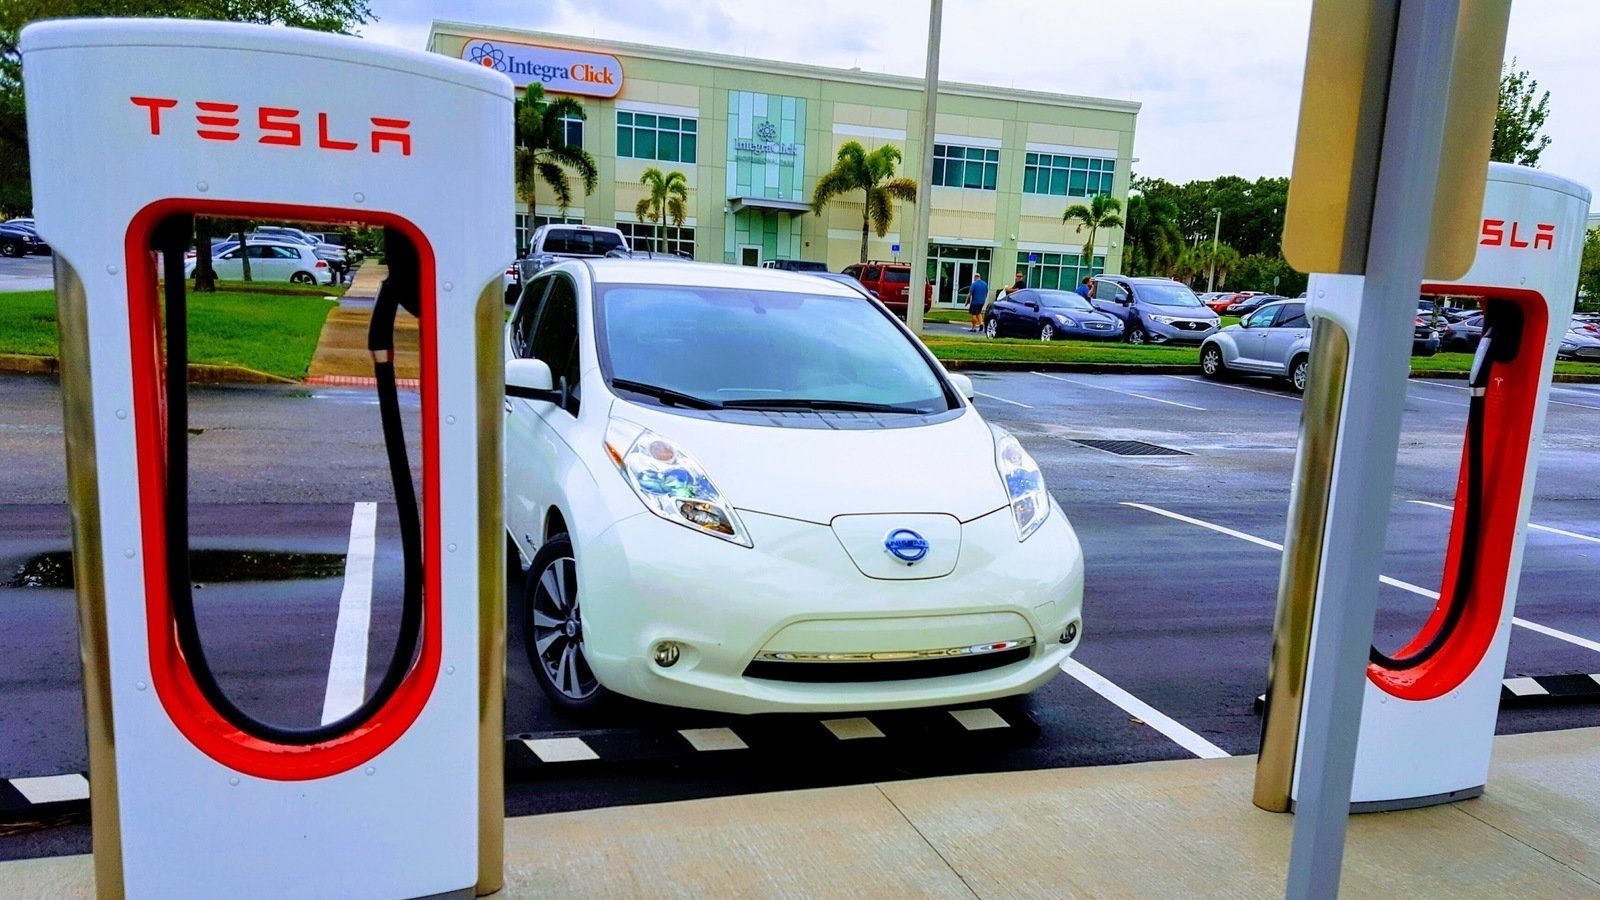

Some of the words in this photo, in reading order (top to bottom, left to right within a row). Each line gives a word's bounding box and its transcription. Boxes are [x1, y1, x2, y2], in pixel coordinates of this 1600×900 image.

[507, 55, 614, 85] IntegraClick
[129, 96, 411, 156] TESLA
[1480, 219, 1555, 250] SLA
